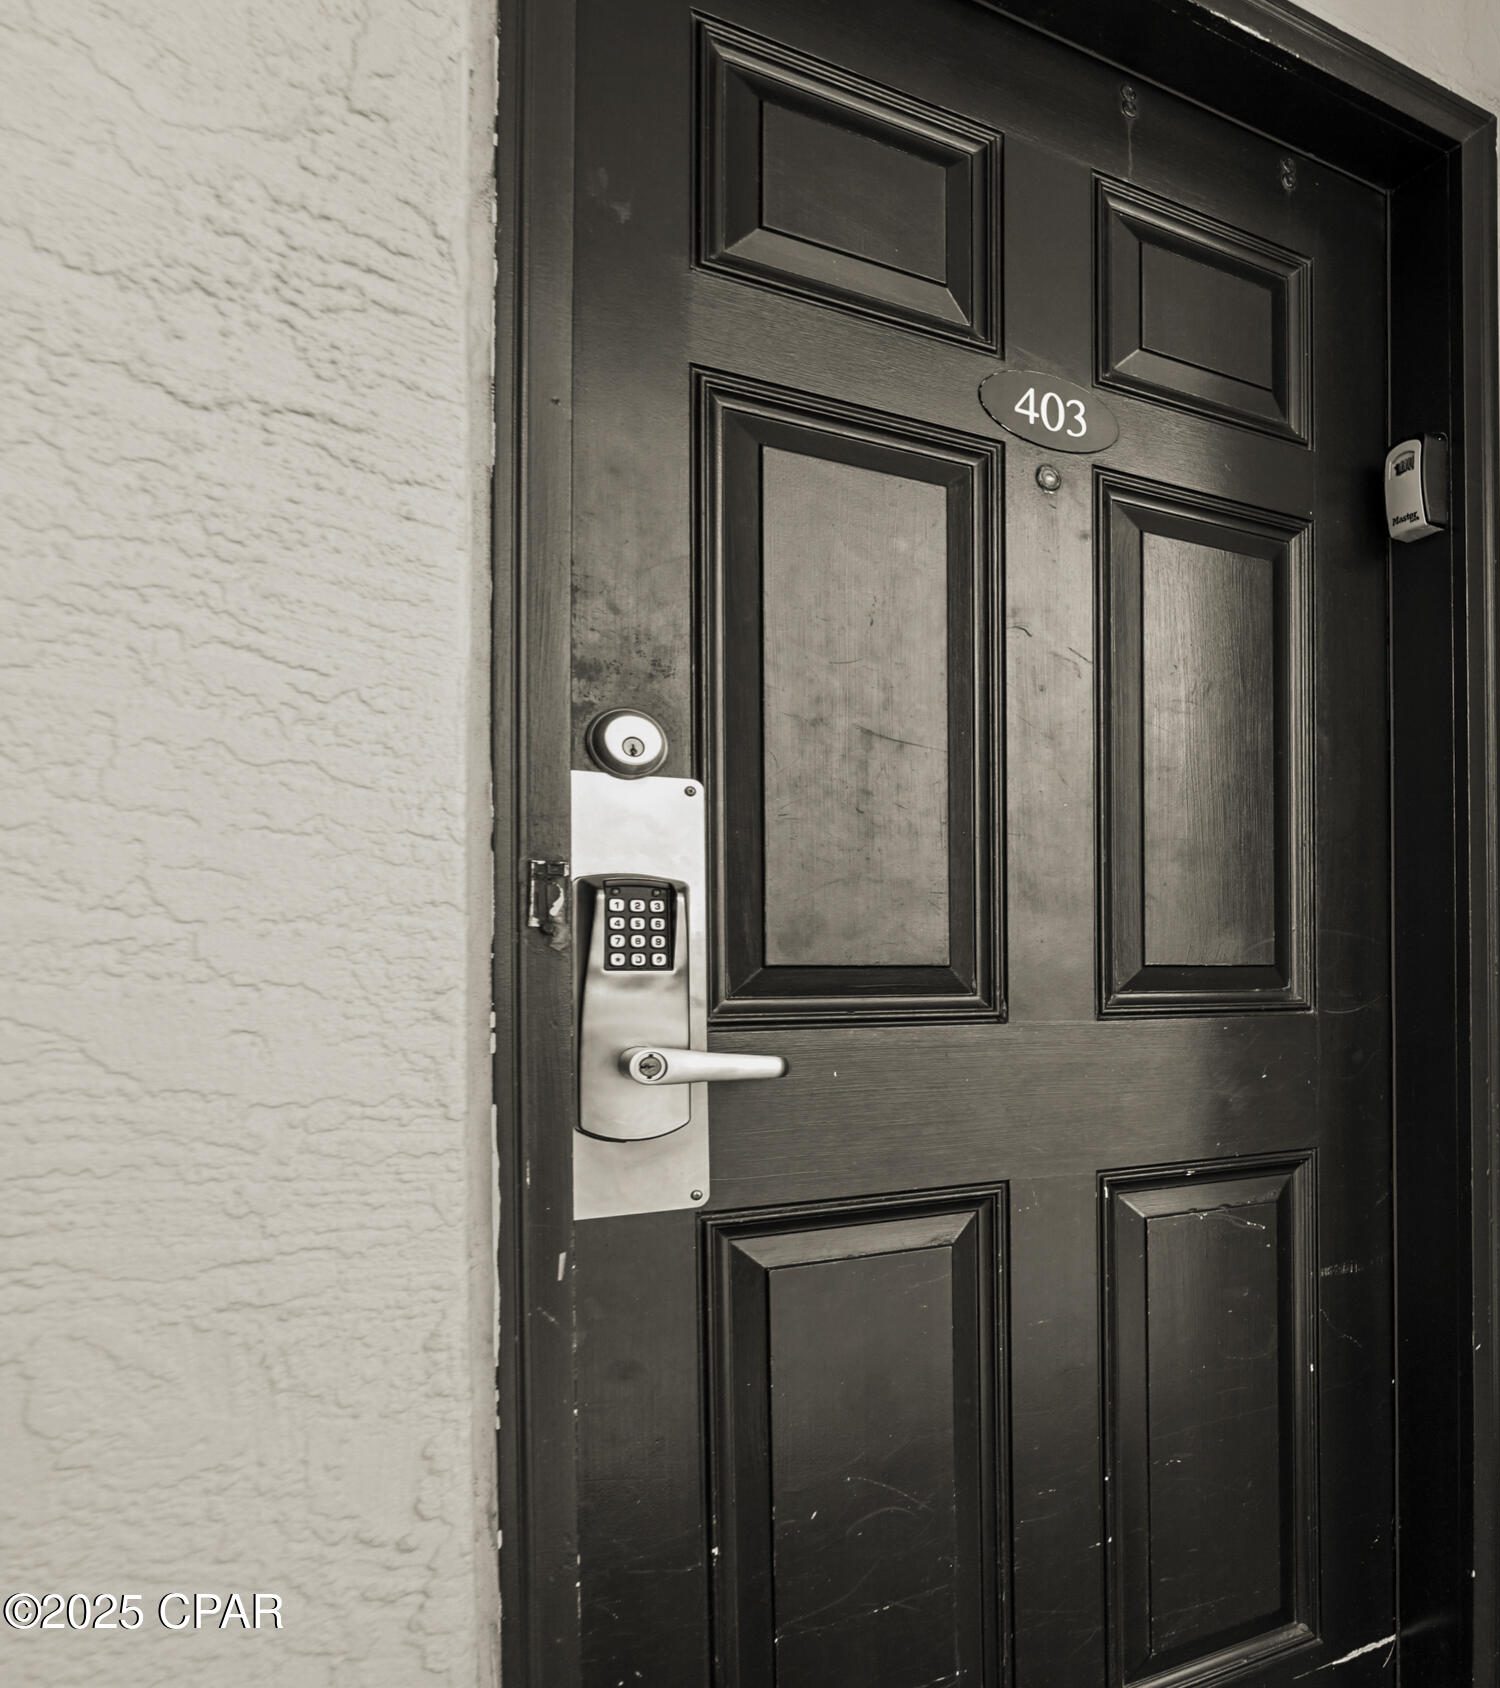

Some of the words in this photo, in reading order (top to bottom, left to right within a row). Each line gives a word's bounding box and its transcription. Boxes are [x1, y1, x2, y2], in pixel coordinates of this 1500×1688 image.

[1014, 387, 1087, 437] 403
[1392, 511, 1418, 526] Master
[634, 902, 641, 910] 2
[654, 902, 661, 910] 3
[634, 920, 641, 928] 5
[655, 920, 662, 928] 6
[614, 937, 621, 945] 7
[634, 937, 641, 945] 8
[655, 938, 662, 946] 9
